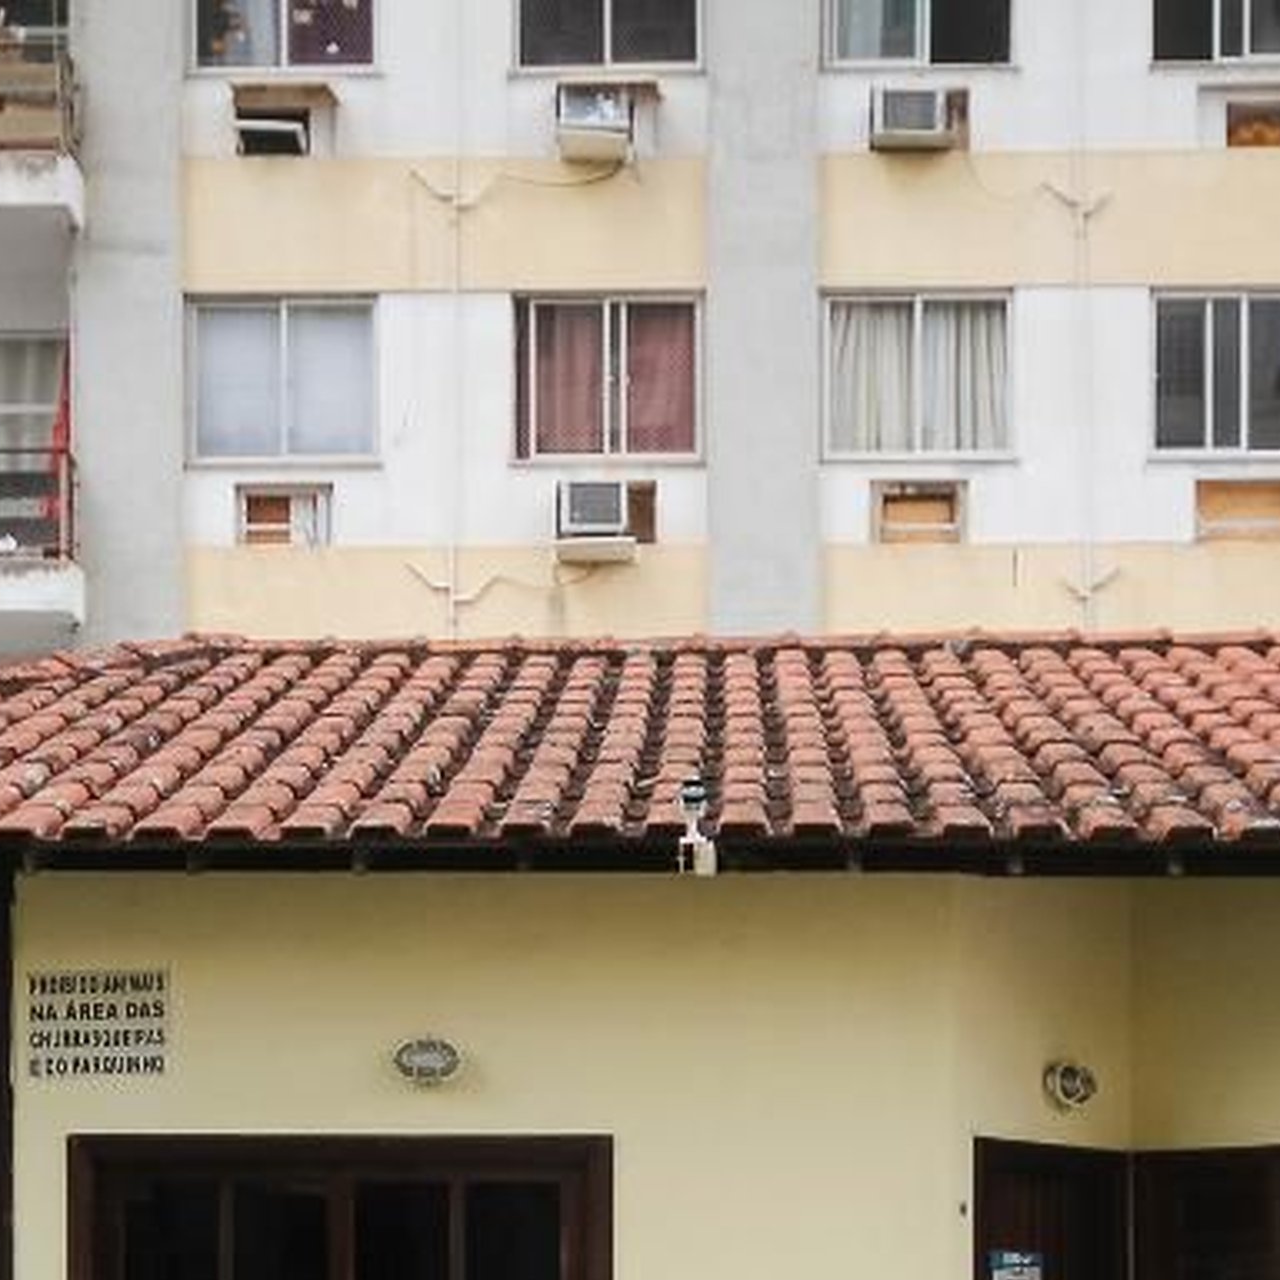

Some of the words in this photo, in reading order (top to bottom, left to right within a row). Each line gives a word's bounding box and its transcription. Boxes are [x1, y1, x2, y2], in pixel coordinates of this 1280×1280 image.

[29, 1004, 58, 1021] NA
[65, 1000, 118, 1021] ÁREA
[126, 1001, 165, 1019] DAS
